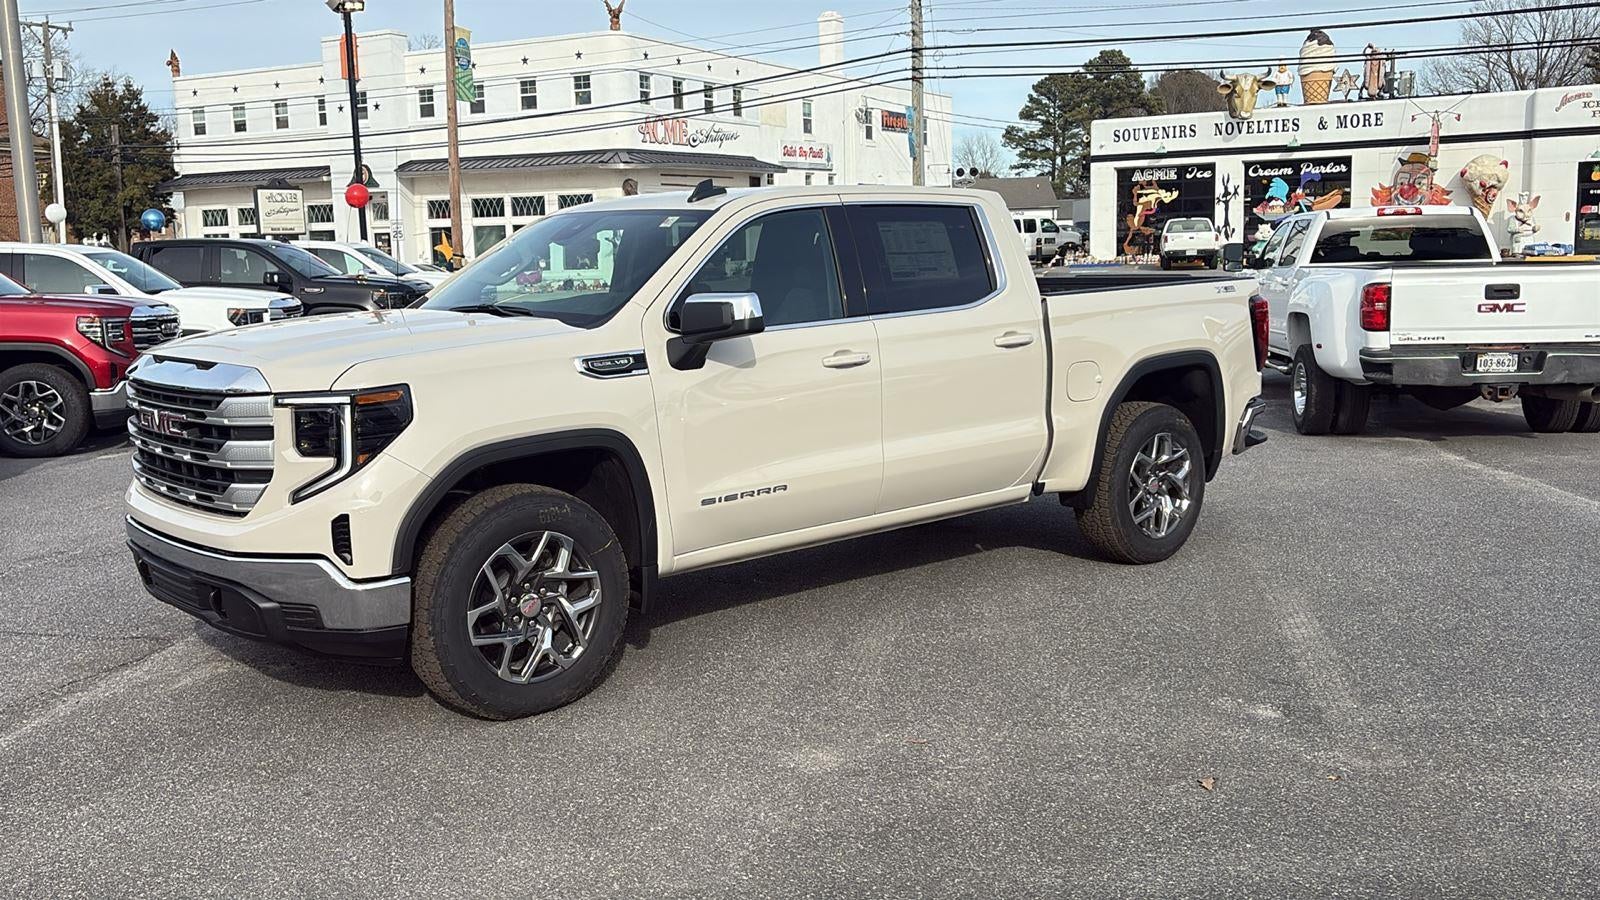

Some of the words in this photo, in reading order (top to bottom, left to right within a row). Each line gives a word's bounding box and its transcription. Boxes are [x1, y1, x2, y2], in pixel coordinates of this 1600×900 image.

[638, 115, 689, 146] ACME
[689, 122, 741, 149] Antiques
[1113, 124, 1197, 143] SOUVENIRS
[1214, 118, 1300, 136] NOVELTIES
[1317, 116, 1329, 131] &
[1335, 112, 1384, 129] MORE
[798, 146, 808, 160] Boy
[1131, 167, 1178, 182] ACME
[1185, 166, 1214, 179] Ice
[1248, 164, 1294, 177] Cream
[1300, 161, 1348, 176] Parlor
[392, 230, 404, 239] 25
[1477, 303, 1526, 313] GMC
[139, 406, 187, 438] GMC
[700, 484, 788, 506] SIERRA
